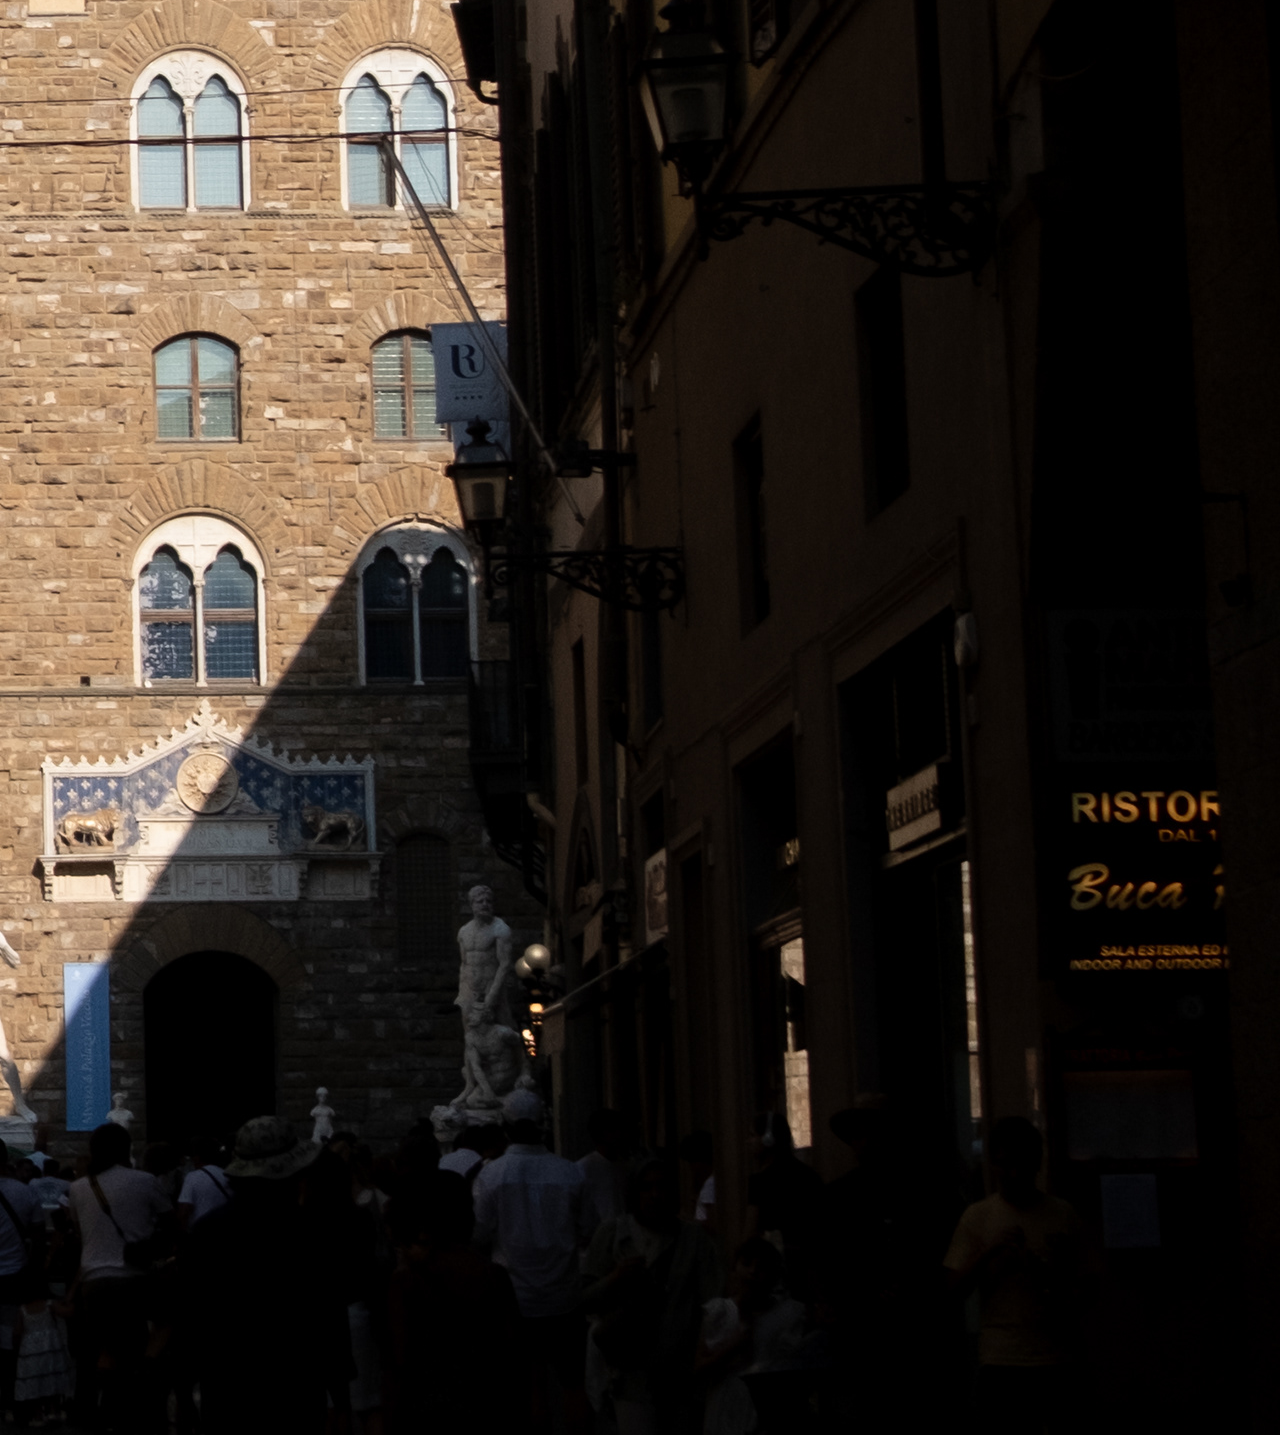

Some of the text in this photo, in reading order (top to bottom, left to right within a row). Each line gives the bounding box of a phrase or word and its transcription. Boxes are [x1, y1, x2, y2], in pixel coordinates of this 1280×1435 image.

[1069, 788, 1222, 824] RISTOR
[1157, 828, 1202, 843] DAL
[1066, 861, 1189, 912] Buca
[1099, 944, 1136, 957] SALA
[1137, 944, 1201, 956] ESTERNA
[1201, 943, 1222, 956] ED
[1069, 958, 1122, 971] INDOOR
[1124, 958, 1153, 970] AND
[1154, 957, 1222, 970] OUTDOOR
